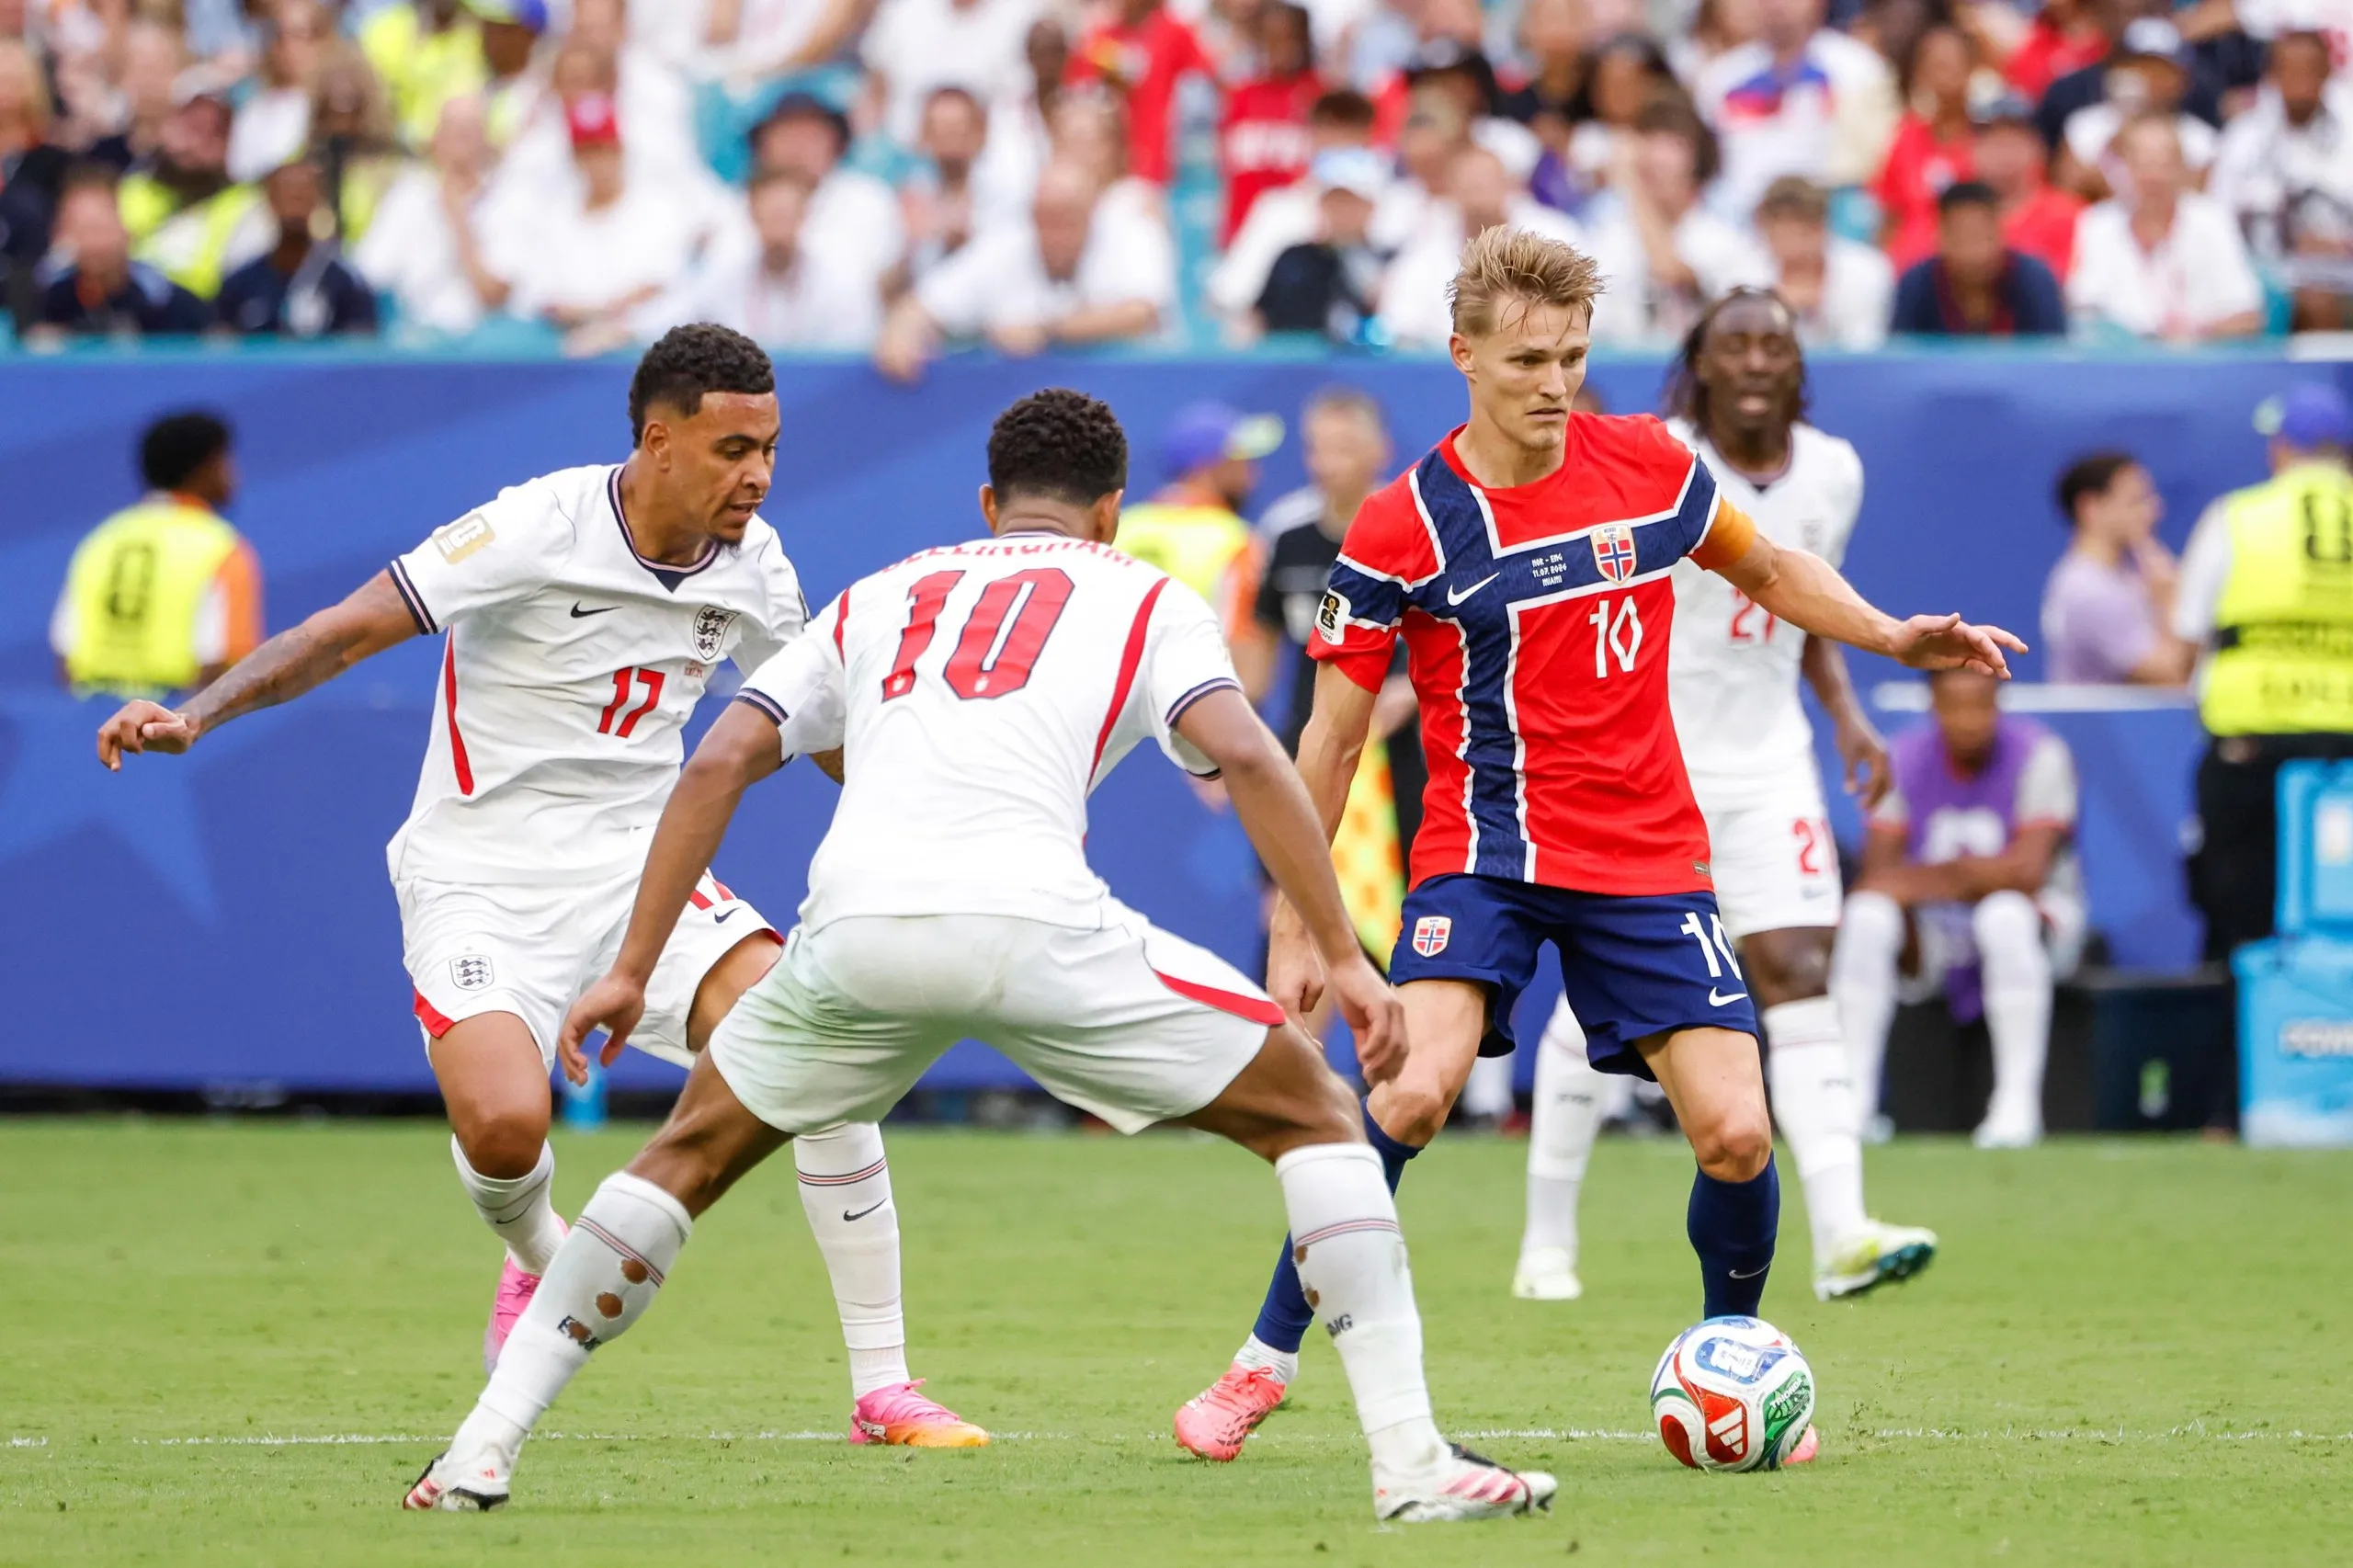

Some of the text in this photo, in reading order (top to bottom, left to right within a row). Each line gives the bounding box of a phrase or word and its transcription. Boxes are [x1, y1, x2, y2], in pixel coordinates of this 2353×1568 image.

[881, 538, 1134, 574] ELLINGHAM
[1531, 557, 1544, 567] NOR
[1550, 552, 1563, 563] ENG
[1541, 574, 1563, 587] MIAMI
[881, 567, 1075, 703] 10
[1589, 595, 1643, 678] 10
[597, 665, 665, 739] 17
